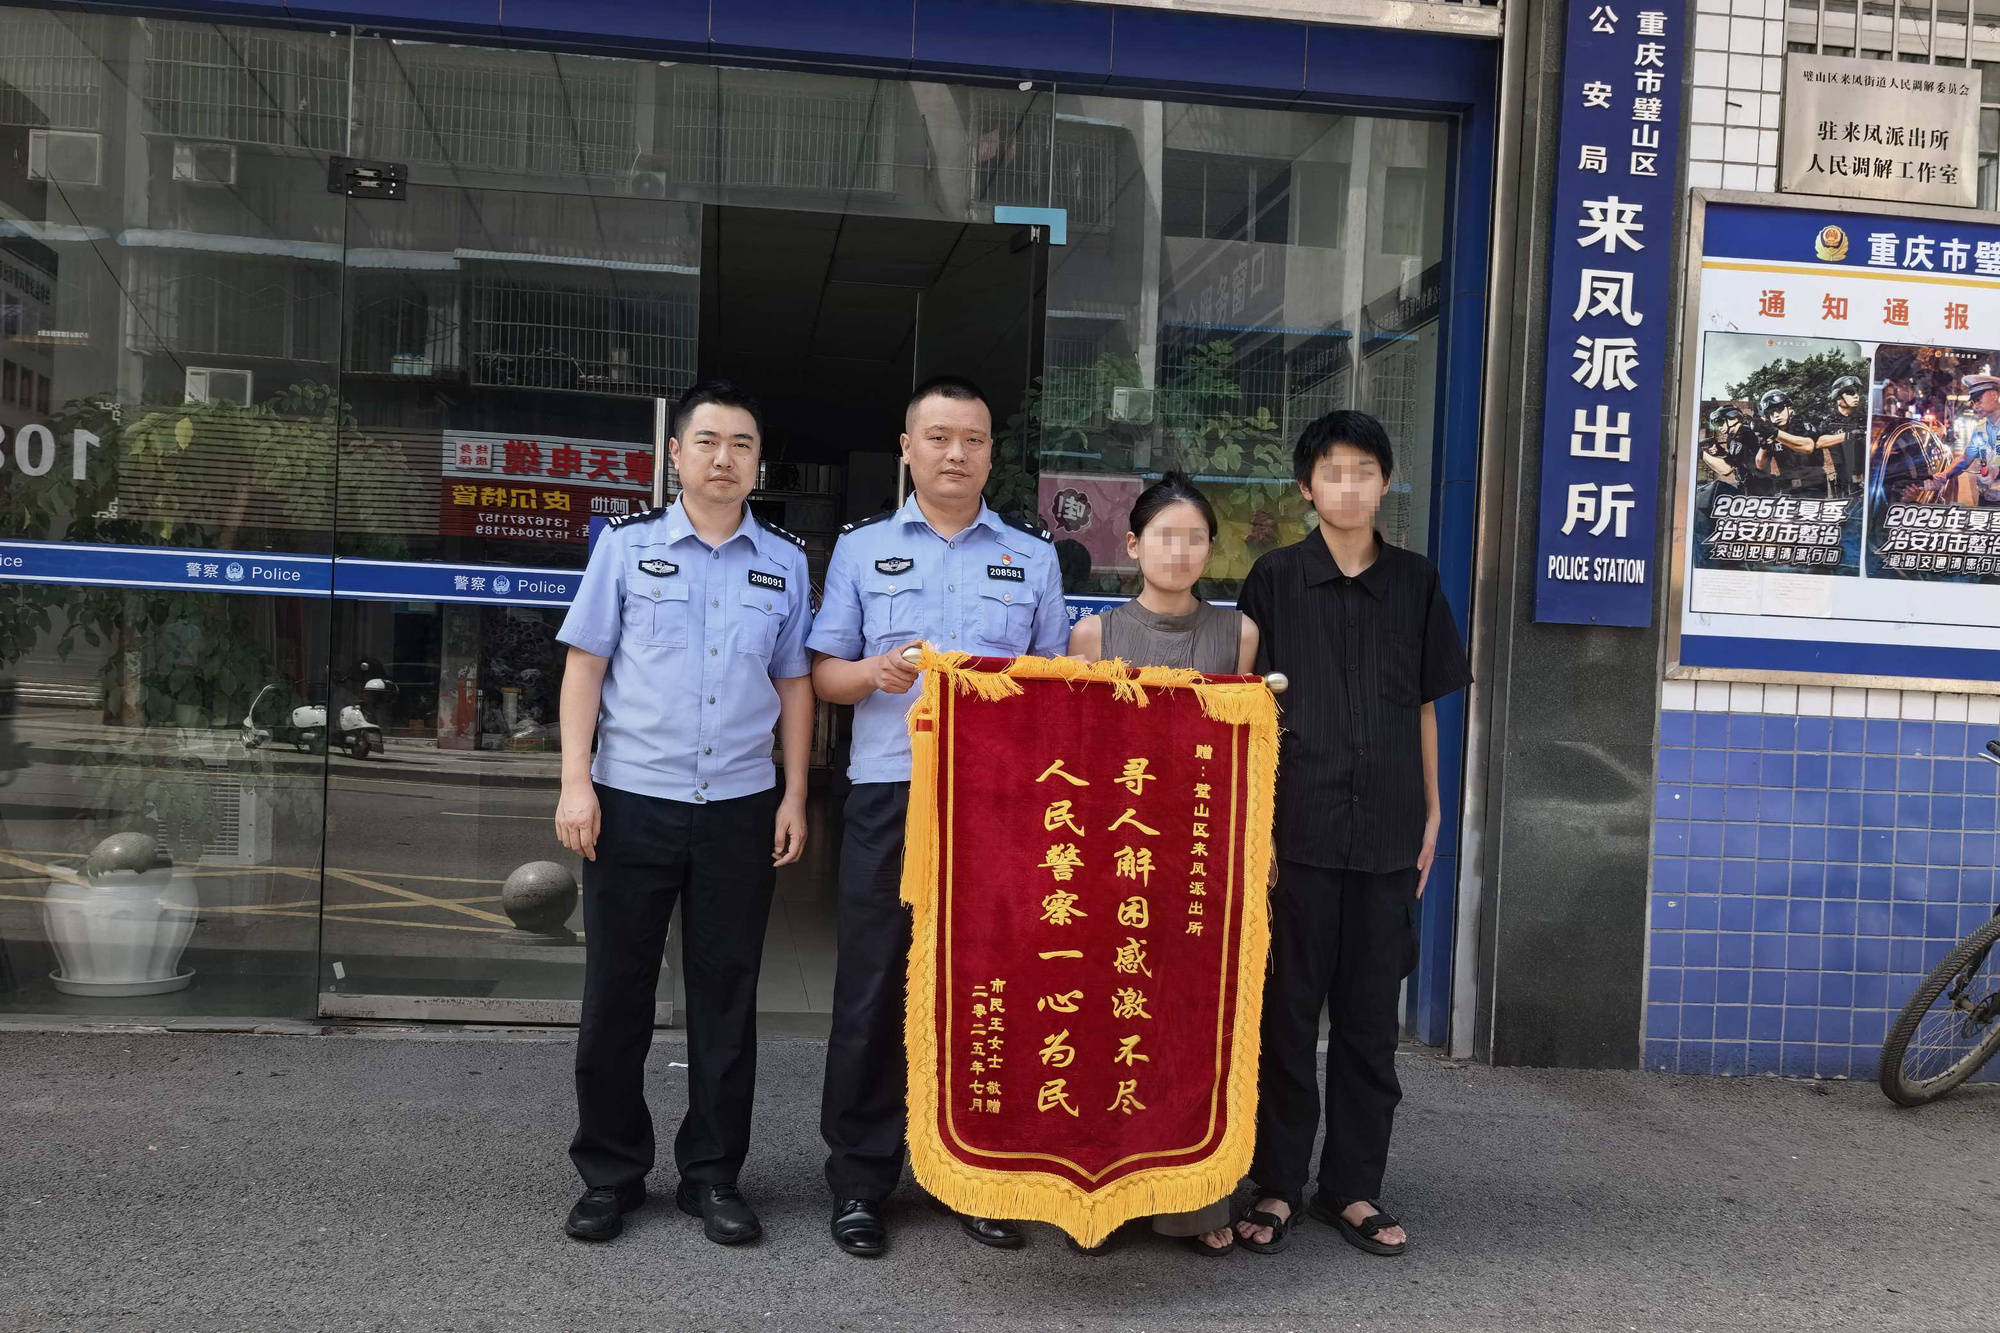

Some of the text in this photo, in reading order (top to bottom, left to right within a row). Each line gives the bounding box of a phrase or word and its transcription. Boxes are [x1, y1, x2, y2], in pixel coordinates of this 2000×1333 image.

[1578, 5, 1619, 174] 公安局
[1630, 11, 1668, 176] 重庆市璧山区
[1803, 70, 1970, 96] 璧山区来凤街道人民调解委员会
[1818, 121, 1950, 151] 驻来凤派出所
[1806, 153, 1959, 184] 人民调解工作室
[1867, 232, 2000, 275] 重庆市璧
[1758, 290, 1970, 331] 通知通报
[1560, 196, 1646, 538] 来凤派出所
[1713, 497, 1849, 521] 2025年夏季
[1709, 519, 1839, 545] 治安打击整治
[186, 561, 219, 579] 警察
[251, 565, 301, 582] Police
[454, 575, 486, 591] 警察
[751, 573, 784, 588] 208091
[989, 567, 1023, 579] 208581
[1548, 554, 1646, 584] POLICE STATION
[518, 579, 566, 594] Police
[1035, 759, 1091, 1117] 人民警察一心为民
[1106, 757, 1161, 1116] 寻人解困感激不尽
[969, 985, 989, 1113] 二零二五年七月
[986, 978, 1006, 1113] 市民王女士 敬赠
